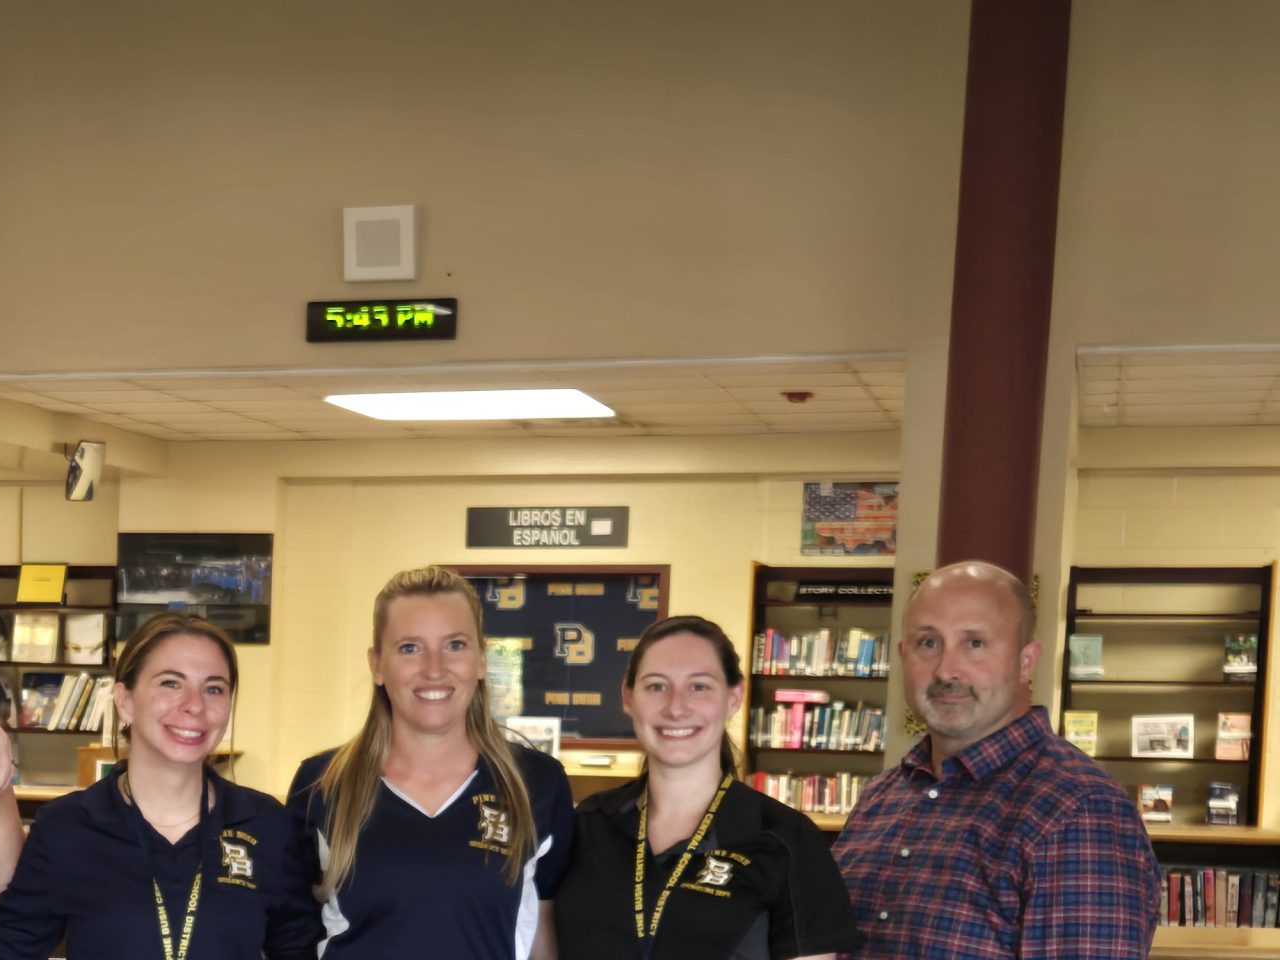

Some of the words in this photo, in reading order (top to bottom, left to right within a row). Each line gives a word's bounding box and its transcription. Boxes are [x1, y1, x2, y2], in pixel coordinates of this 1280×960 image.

[508, 510, 562, 526] LIBROS
[565, 510, 587, 526] EN
[513, 527, 580, 546] ESPAÑOL
[687, 813, 714, 850] CENTRAL
[635, 841, 647, 882] CENTRAL
[666, 852, 693, 888] SCHOOL
[187, 873, 202, 913] SCHOOL
[634, 884, 644, 911] BUSH
[158, 906, 170, 935] BUSH
[635, 913, 645, 938] PINE
[649, 889, 671, 937] DISTRICT
